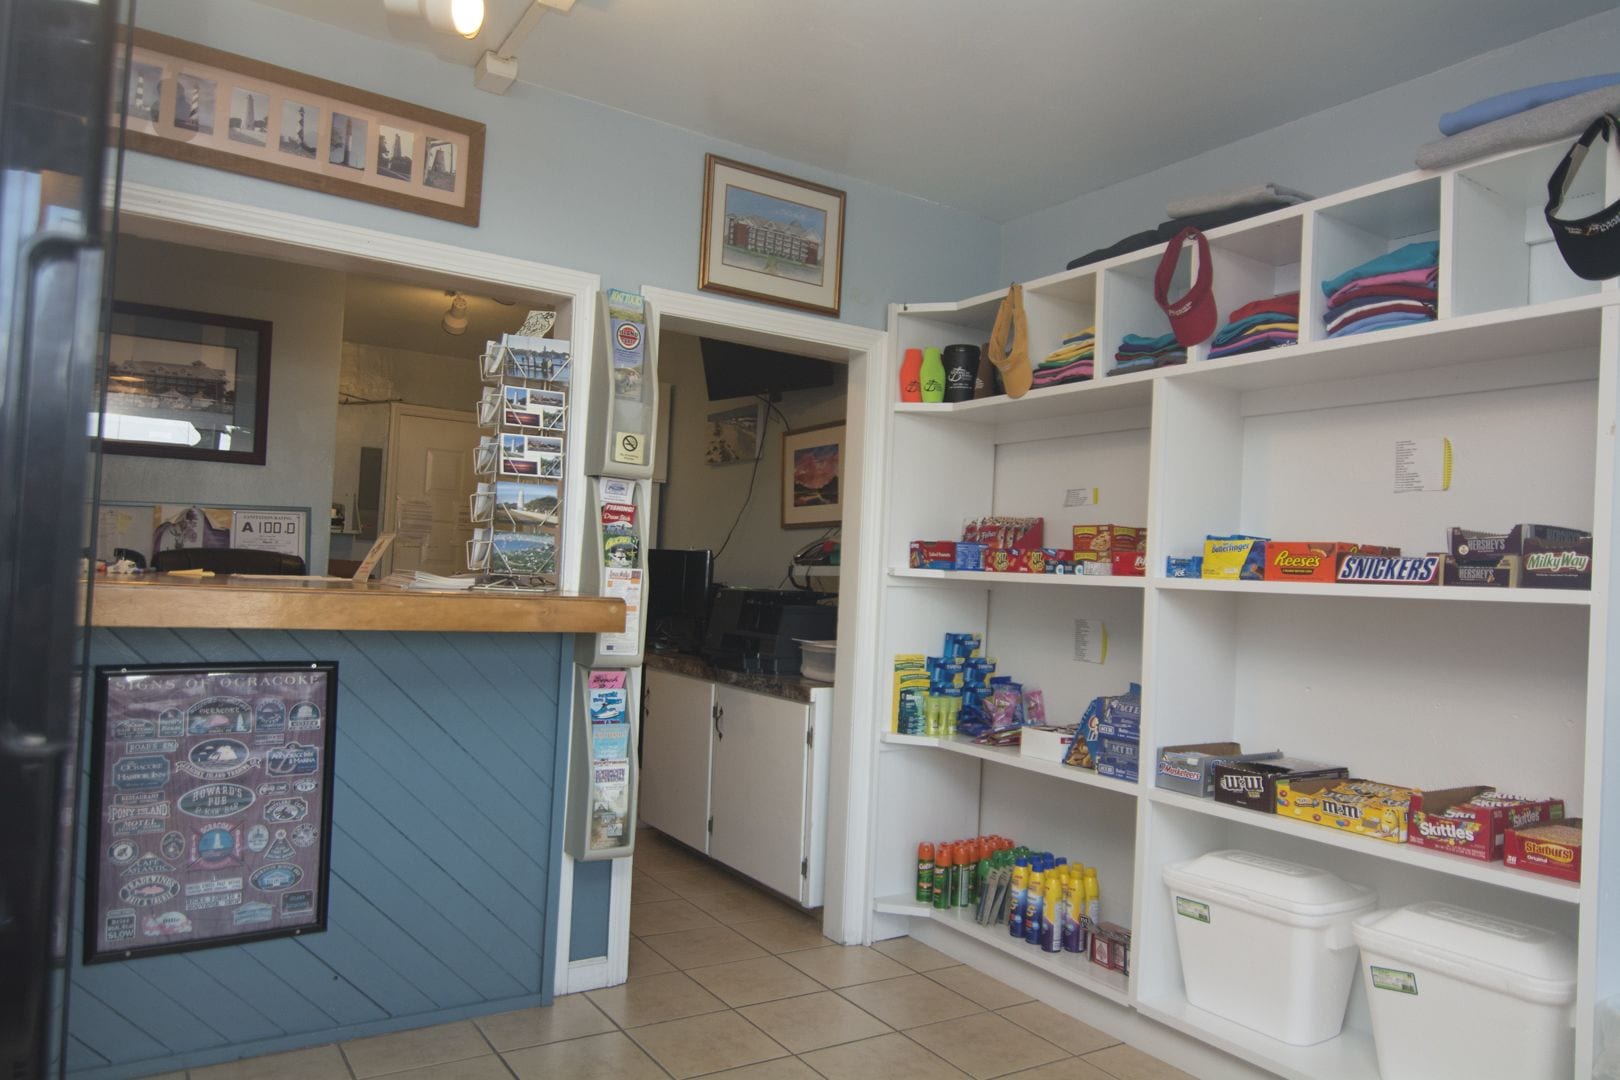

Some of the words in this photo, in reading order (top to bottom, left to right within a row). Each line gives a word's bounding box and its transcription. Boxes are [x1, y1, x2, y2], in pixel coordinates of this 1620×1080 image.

[242, 522, 254, 533] A
[1211, 542, 1250, 554] Butterfinger
[1467, 538, 1506, 551] HERSHEY'S
[1274, 550, 1320, 567] Reese's
[1340, 556, 1437, 581] SNICKERS
[1458, 568, 1495, 579] HERSHEY'S
[115, 679, 177, 690] SIGNS
[186, 678, 209, 689] OF
[220, 675, 320, 687] OCRACOKE
[1164, 764, 1201, 781] Musketeers
[192, 785, 243, 801] HOWARD'S
[208, 796, 227, 807] PUB
[111, 806, 136, 820] PONY
[137, 803, 168, 816] ISLAND
[124, 819, 157, 828] MOTEL
[1419, 822, 1475, 842] Skittles
[1526, 842, 1573, 860] Starburst
[107, 929, 134, 939] SLOW
